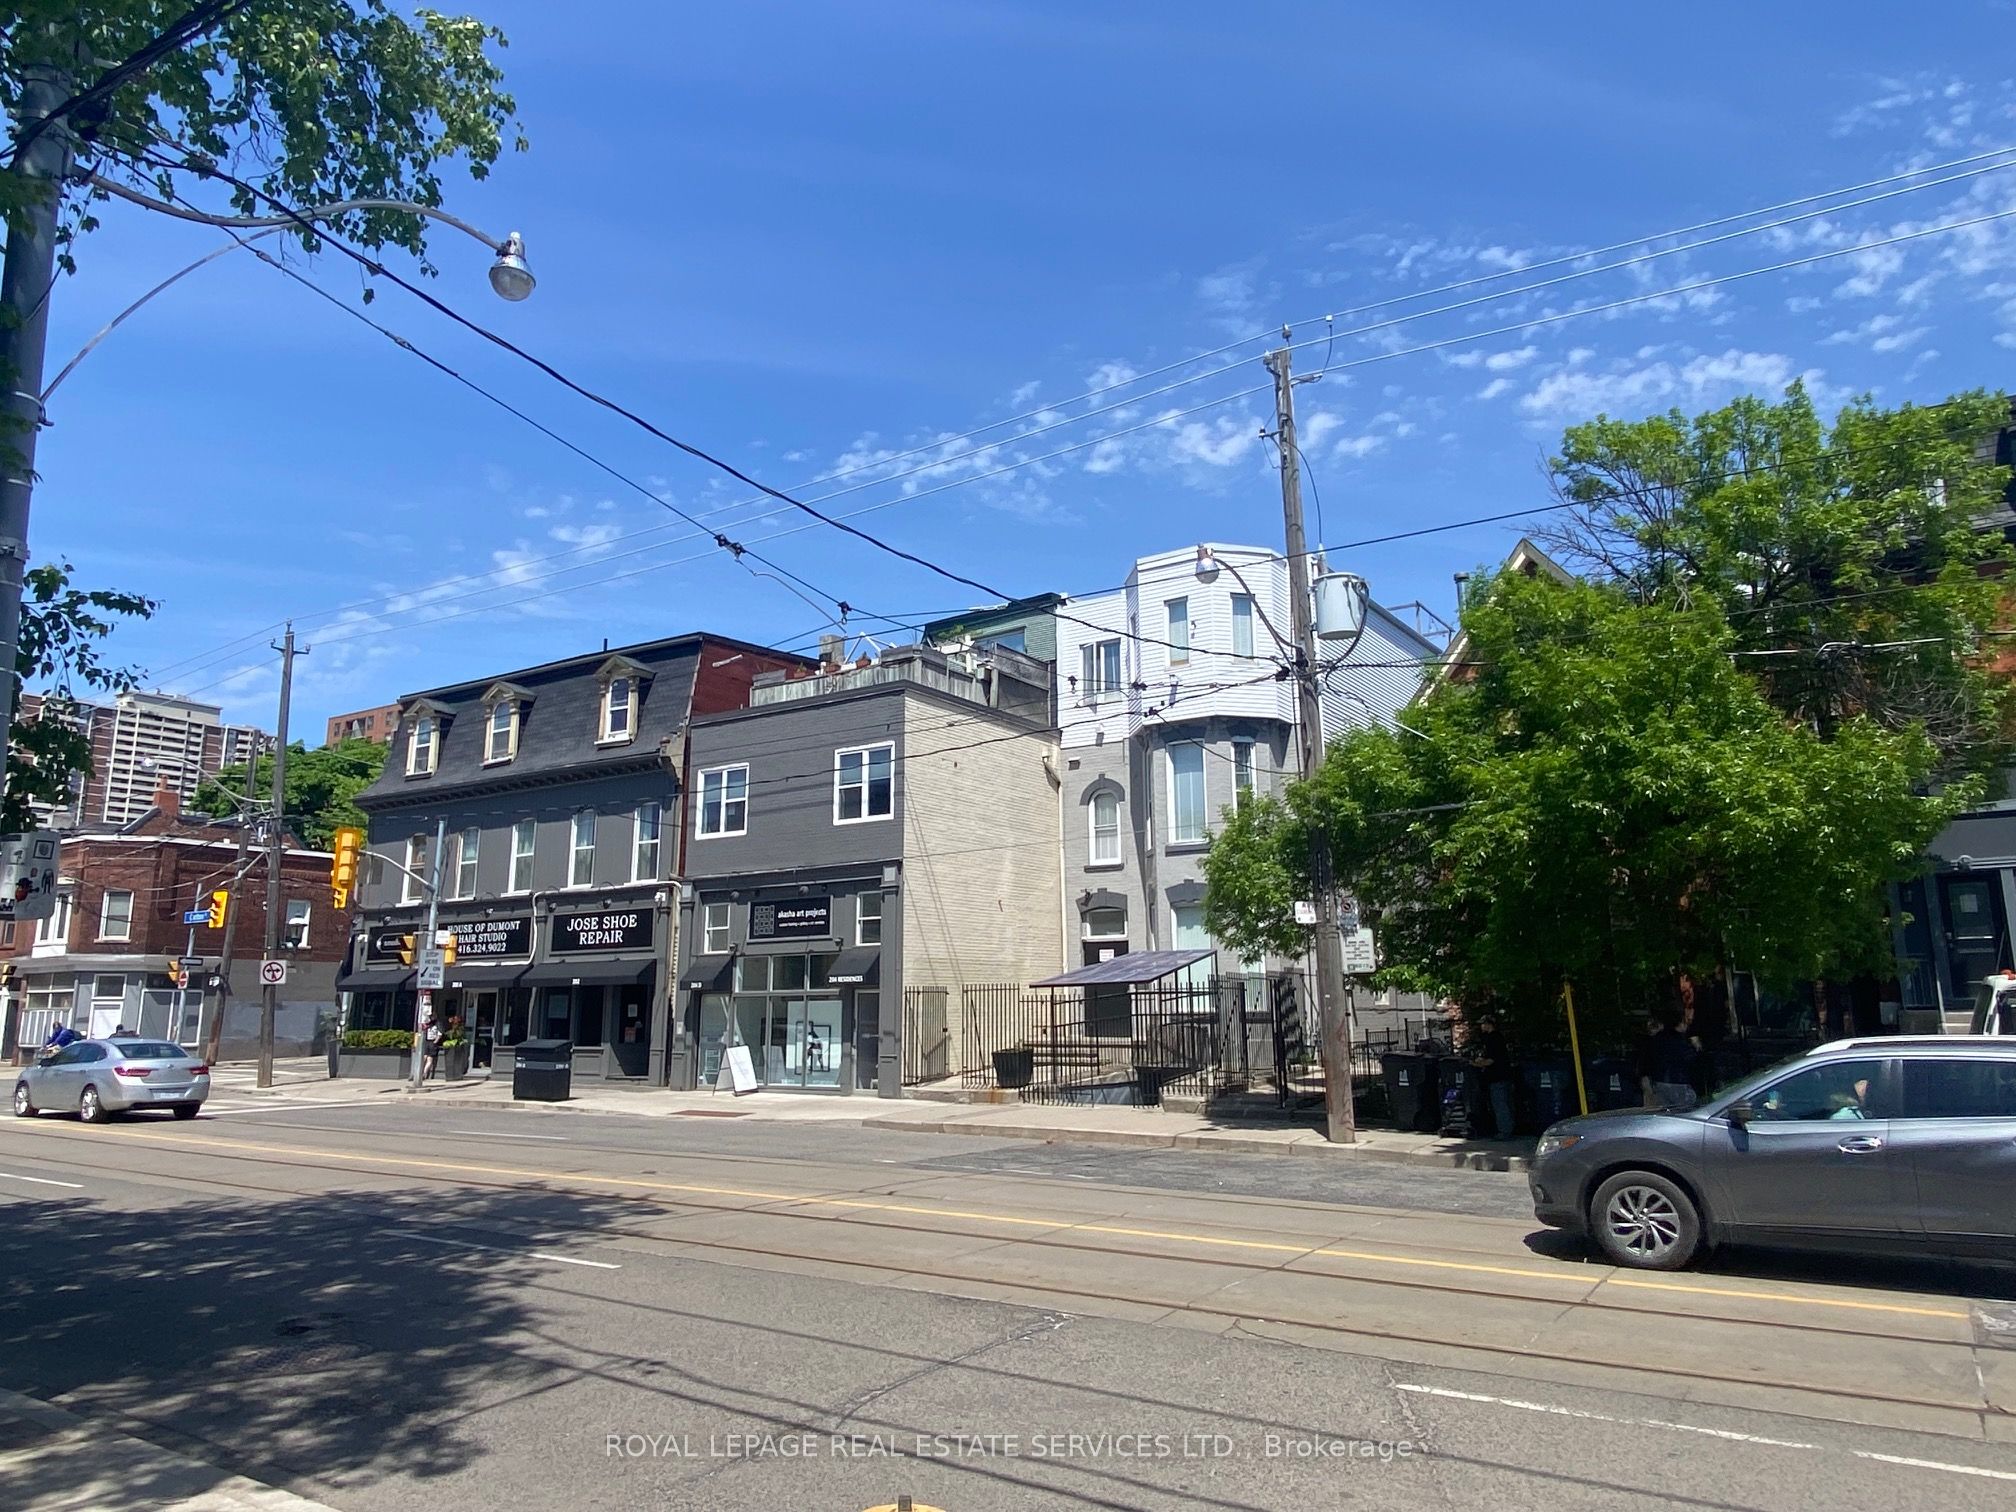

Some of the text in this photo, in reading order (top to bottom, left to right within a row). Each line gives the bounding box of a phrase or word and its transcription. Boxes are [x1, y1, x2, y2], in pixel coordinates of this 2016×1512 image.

[778, 910, 795, 918] akasha
[805, 908, 827, 918] projects
[447, 921, 520, 934] HOUSE OF DUMONT
[566, 914, 638, 931] JOSE SHOE
[458, 934, 477, 943] HAIR
[478, 932, 507, 942] STUDIO
[579, 930, 623, 945] REPAIR
